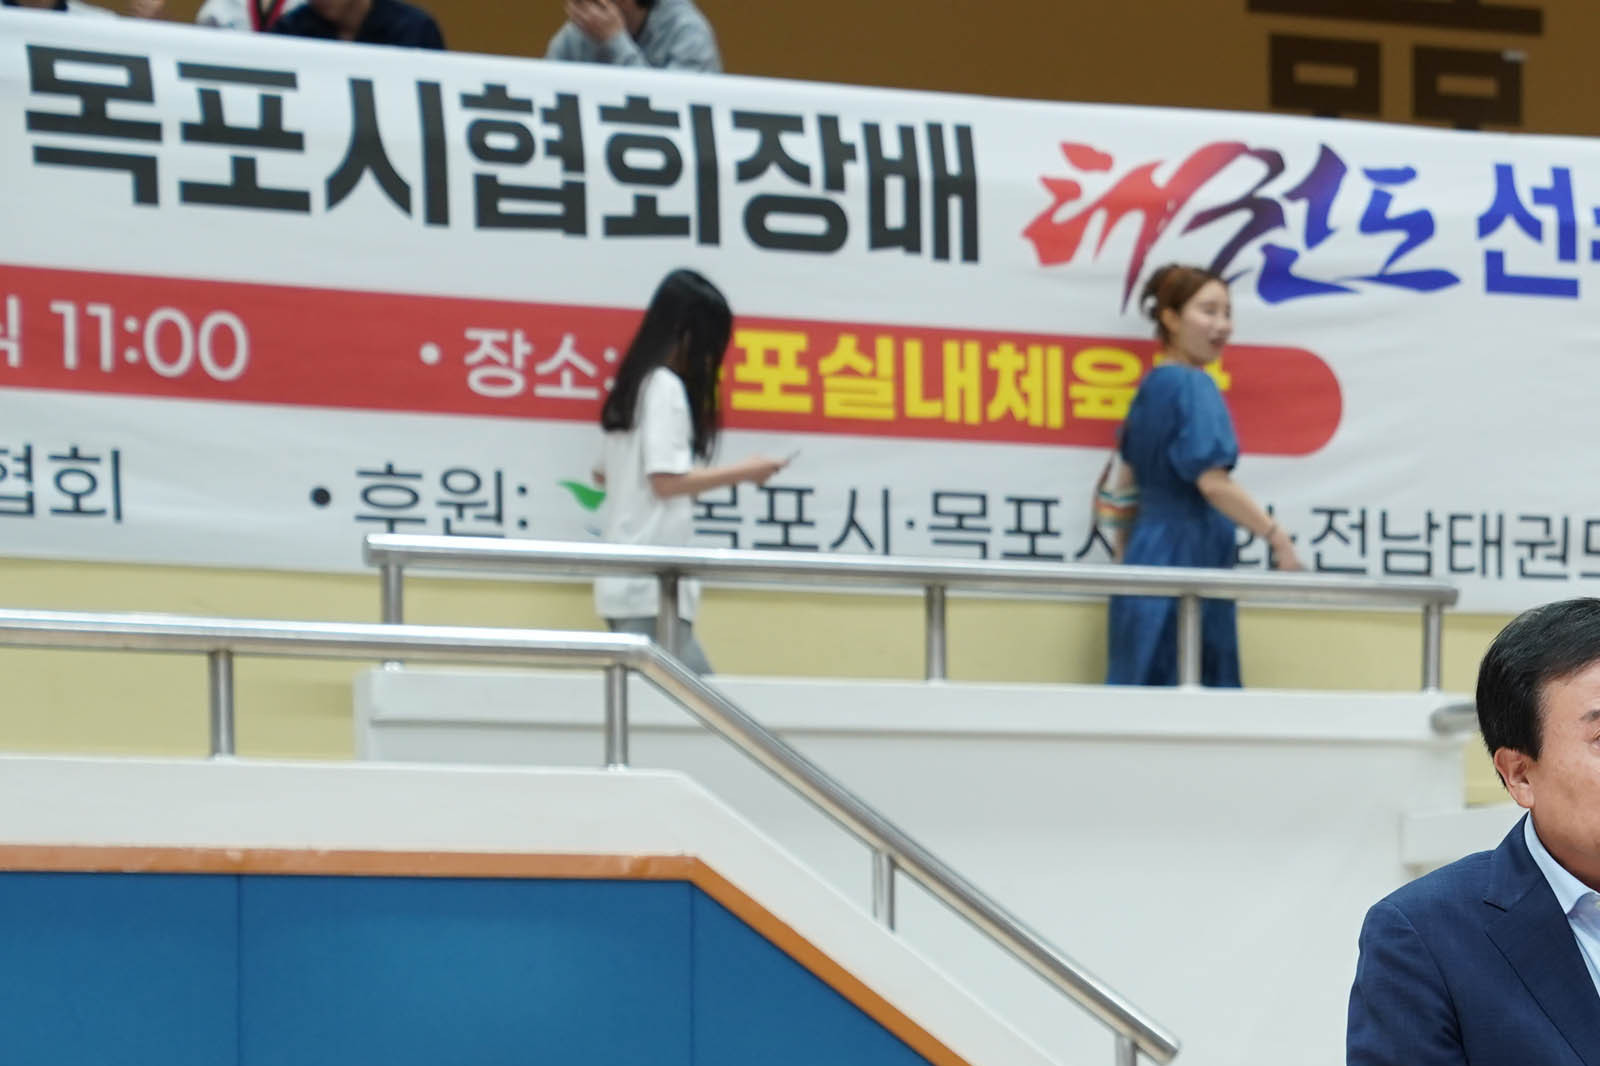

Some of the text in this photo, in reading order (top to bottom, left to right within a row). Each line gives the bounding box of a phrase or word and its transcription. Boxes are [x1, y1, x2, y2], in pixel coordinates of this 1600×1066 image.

[25, 44, 981, 264] 목포시협회장배
[1020, 141, 1462, 316] 태권도
[48, 300, 250, 382] 11:00
[463, 327, 1232, 430] 장소: 포실내체육
[354, 461, 529, 538] 후원:
